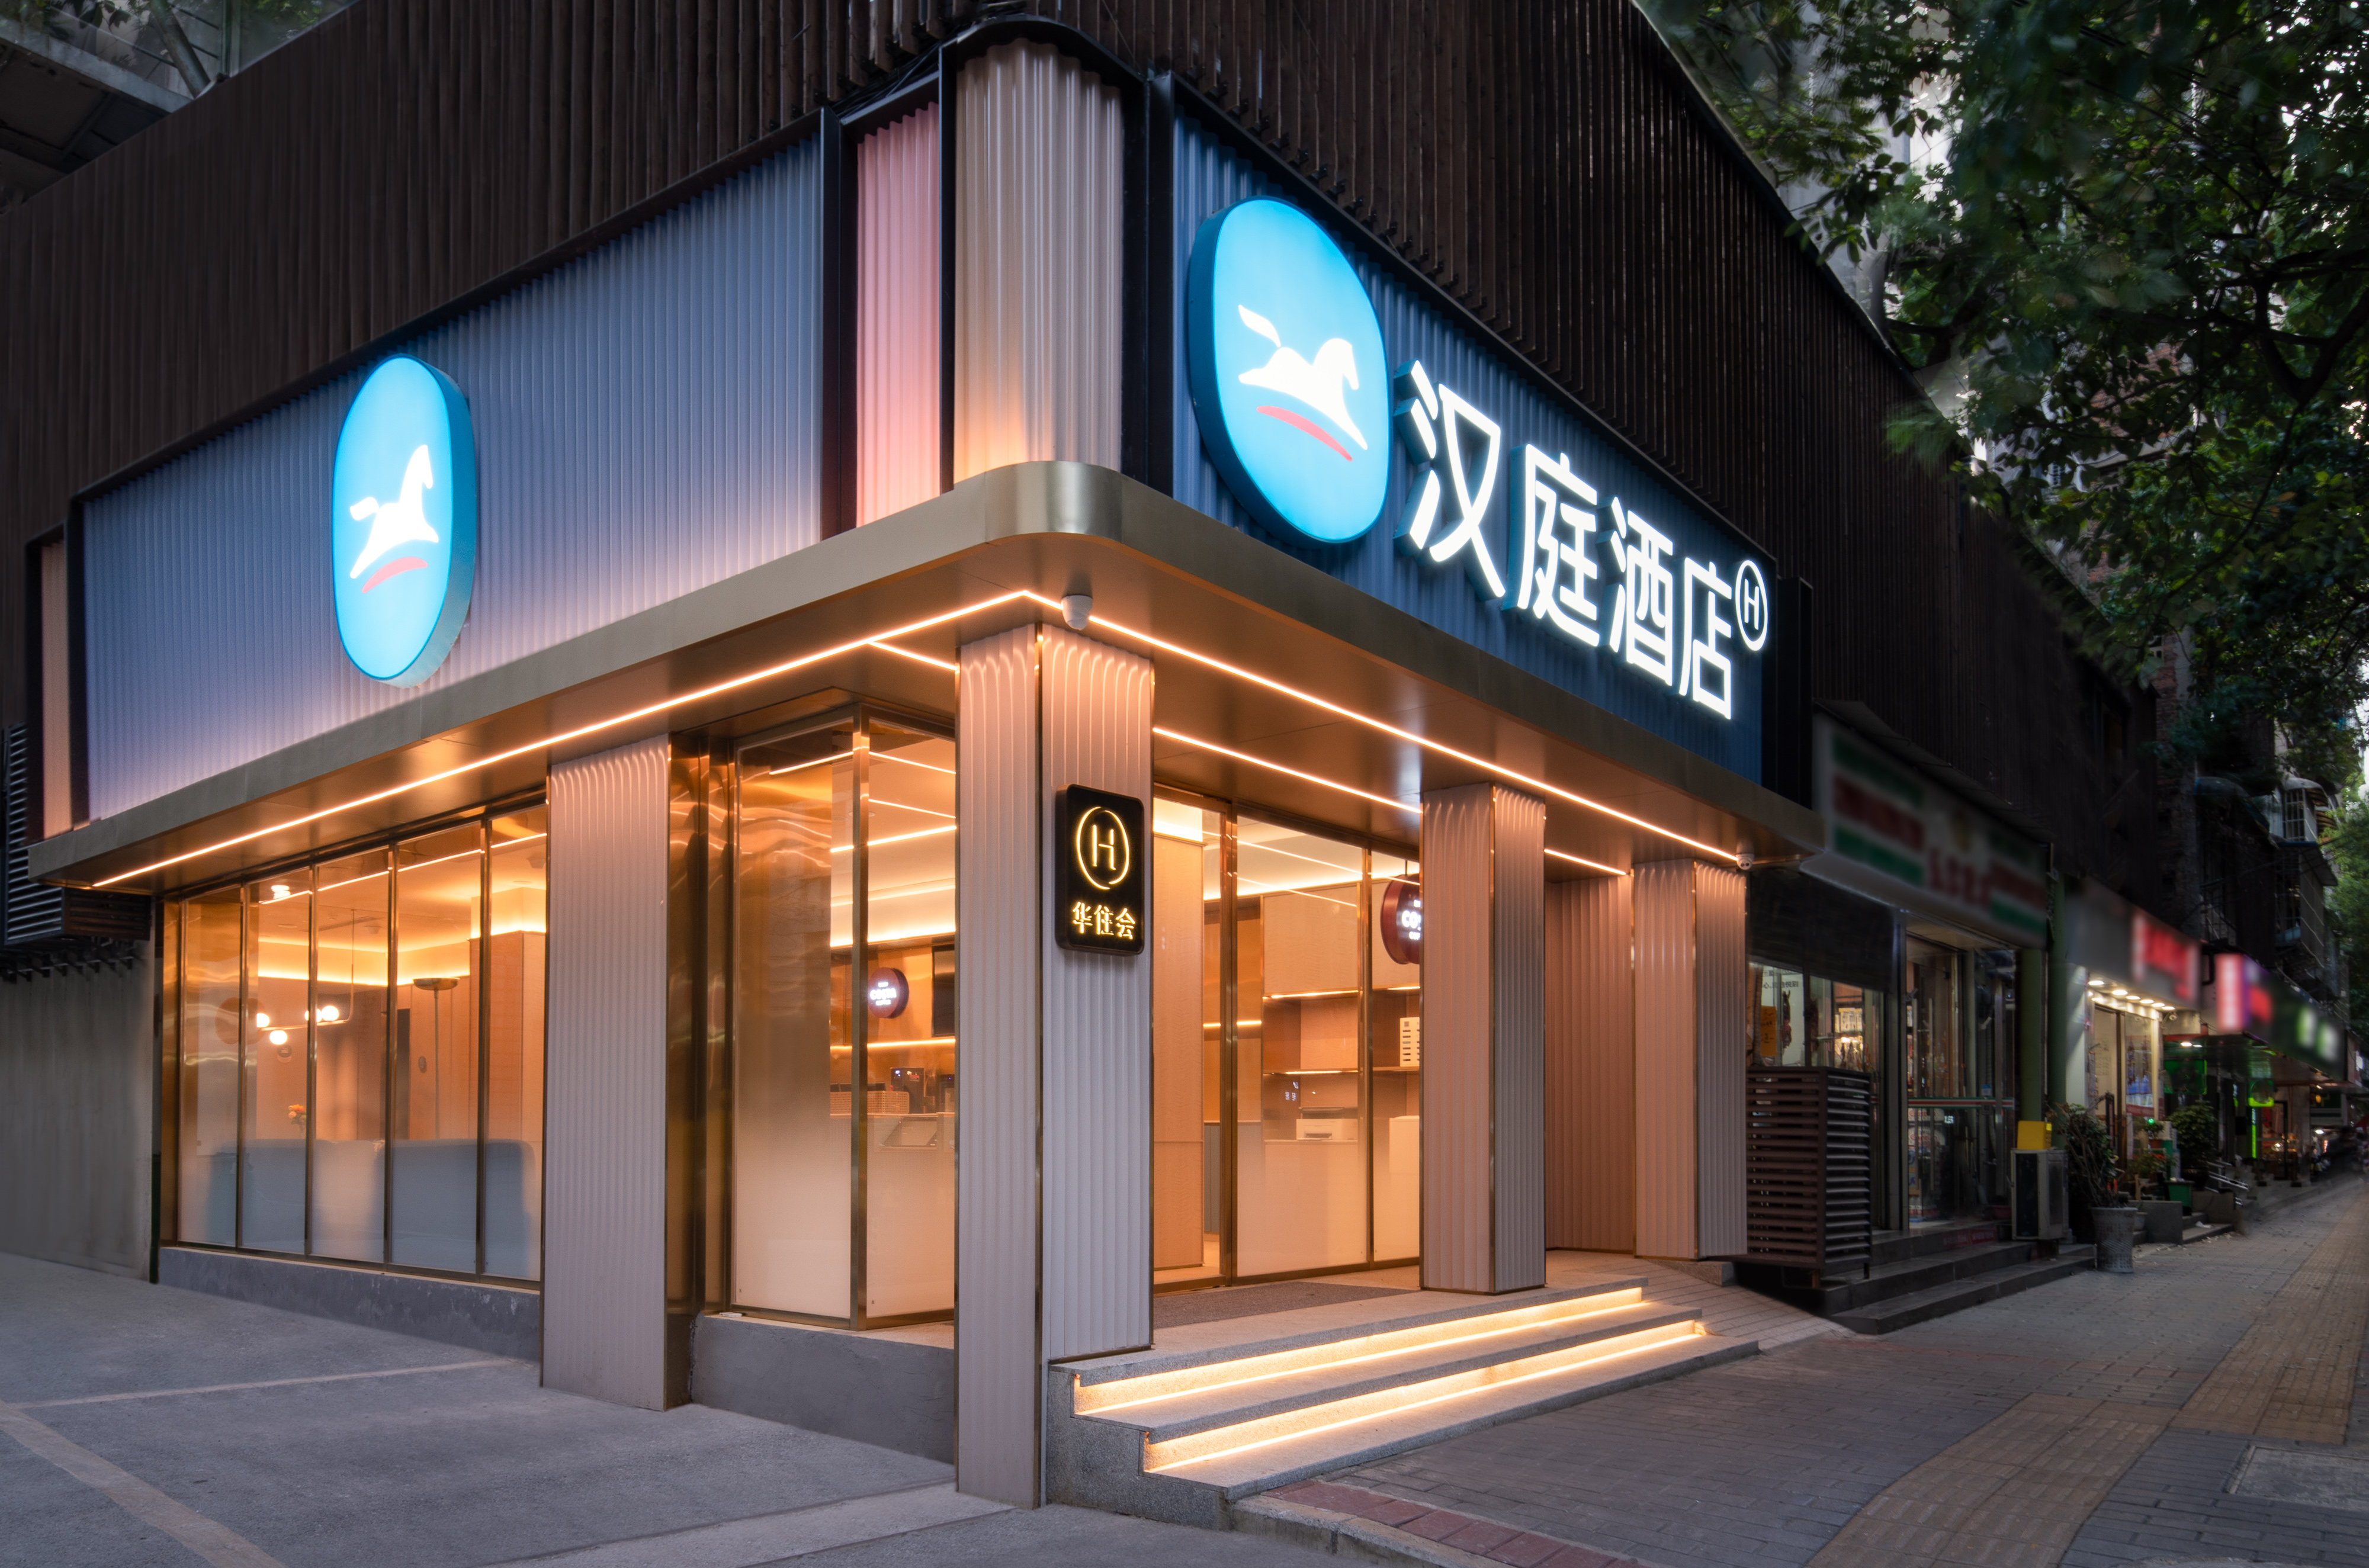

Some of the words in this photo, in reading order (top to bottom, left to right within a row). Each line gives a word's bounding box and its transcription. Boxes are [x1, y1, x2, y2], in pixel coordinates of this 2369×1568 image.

[1410, 360, 1732, 719] 汉庭酒店
[1072, 901, 1136, 940] 华住会
